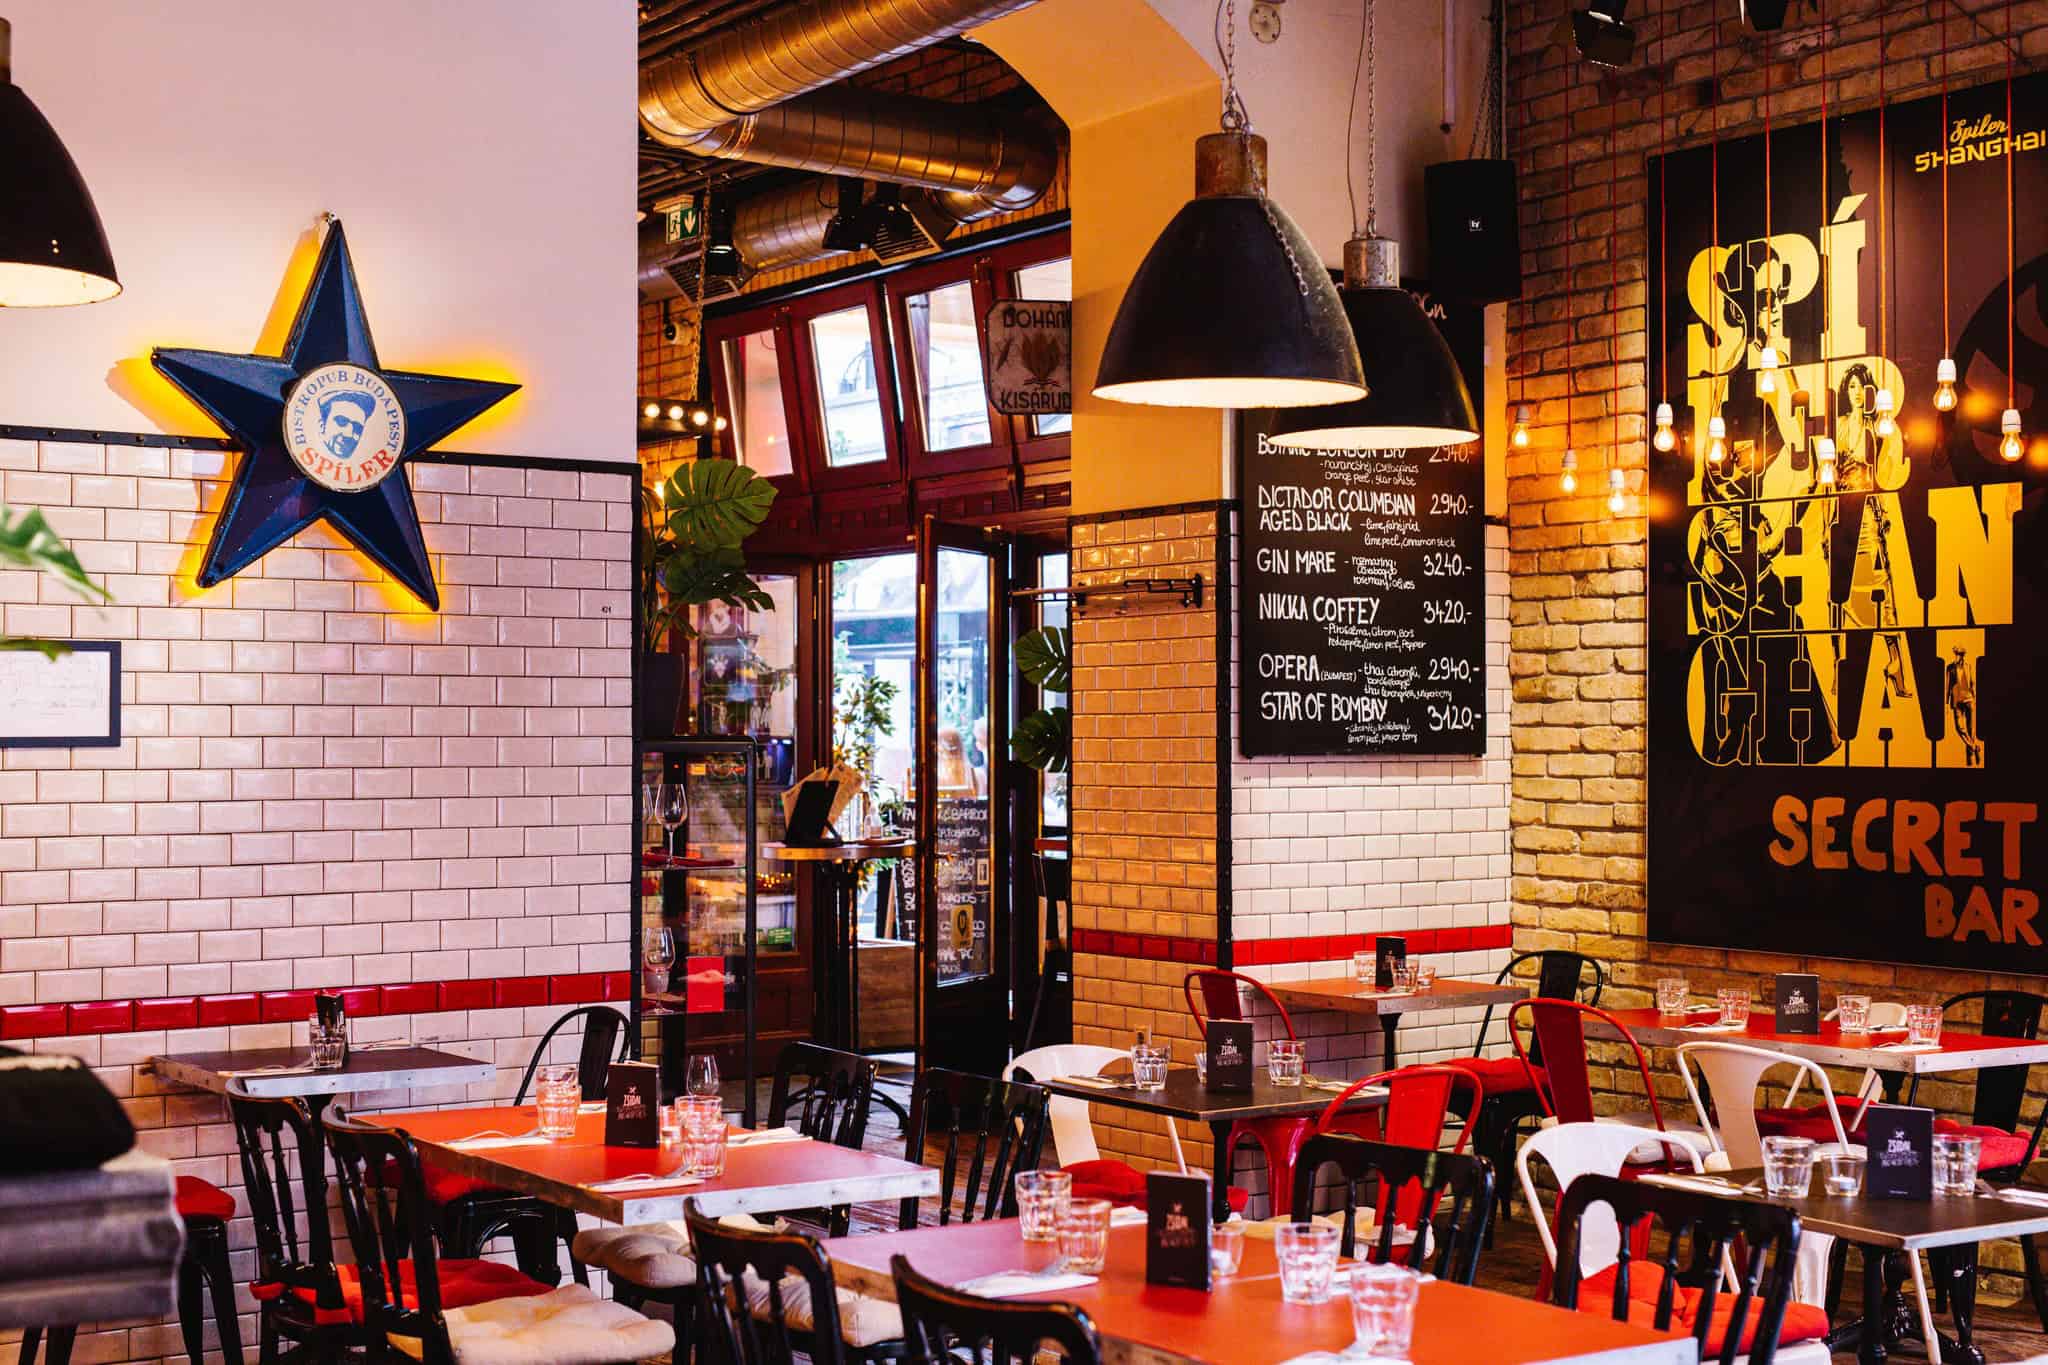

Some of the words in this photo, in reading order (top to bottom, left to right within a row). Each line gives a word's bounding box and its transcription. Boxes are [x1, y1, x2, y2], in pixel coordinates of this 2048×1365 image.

[293, 370, 348, 445] BISTROPUB
[353, 372, 400, 453] BUDAPEST
[1258, 485, 1336, 510] DICTADOR
[1337, 489, 1416, 516] COLUMBIAN
[1259, 510, 1304, 532] AGED
[1306, 511, 1353, 532] BLACK
[1257, 548, 1289, 575] GIN
[1295, 550, 1337, 575] MARE
[1258, 592, 1309, 622] NIKKA
[1312, 596, 1381, 625] COFFEY
[1258, 653, 1320, 682] OPERA
[1260, 691, 1303, 722] STAR
[1304, 692, 1327, 721] OF
[1331, 692, 1389, 723] BOMBAY
[1768, 794, 2038, 880] SECRET
[1924, 883, 2043, 946] BAR
